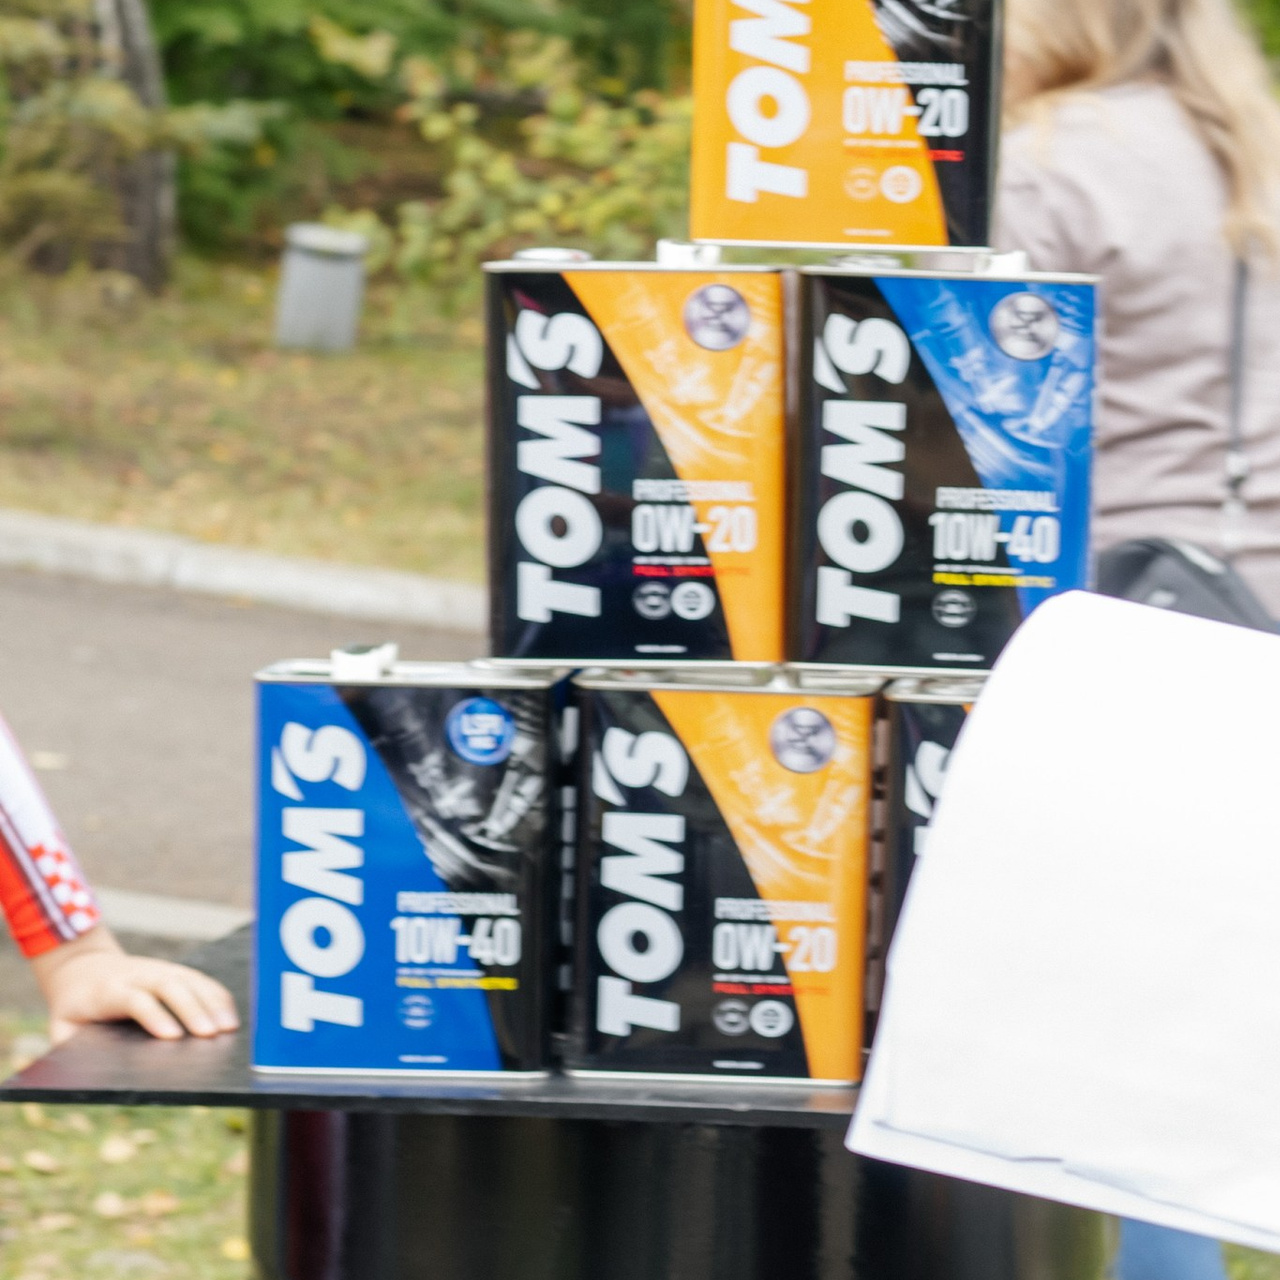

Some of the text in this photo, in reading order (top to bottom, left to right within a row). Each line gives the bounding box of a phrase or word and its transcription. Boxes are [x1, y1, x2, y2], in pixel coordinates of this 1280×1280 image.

[843, 86, 970, 138] 0W-20
[505, 308, 603, 624] TOM'S
[812, 313, 911, 629] TOM'S
[631, 503, 757, 553] 0W-20
[928, 511, 1061, 564] 10W-40
[271, 721, 367, 1033] TOM'S
[592, 726, 689, 1038] TOM'S
[389, 916, 522, 967] 10W-40
[712, 922, 837, 973] 0W-20
